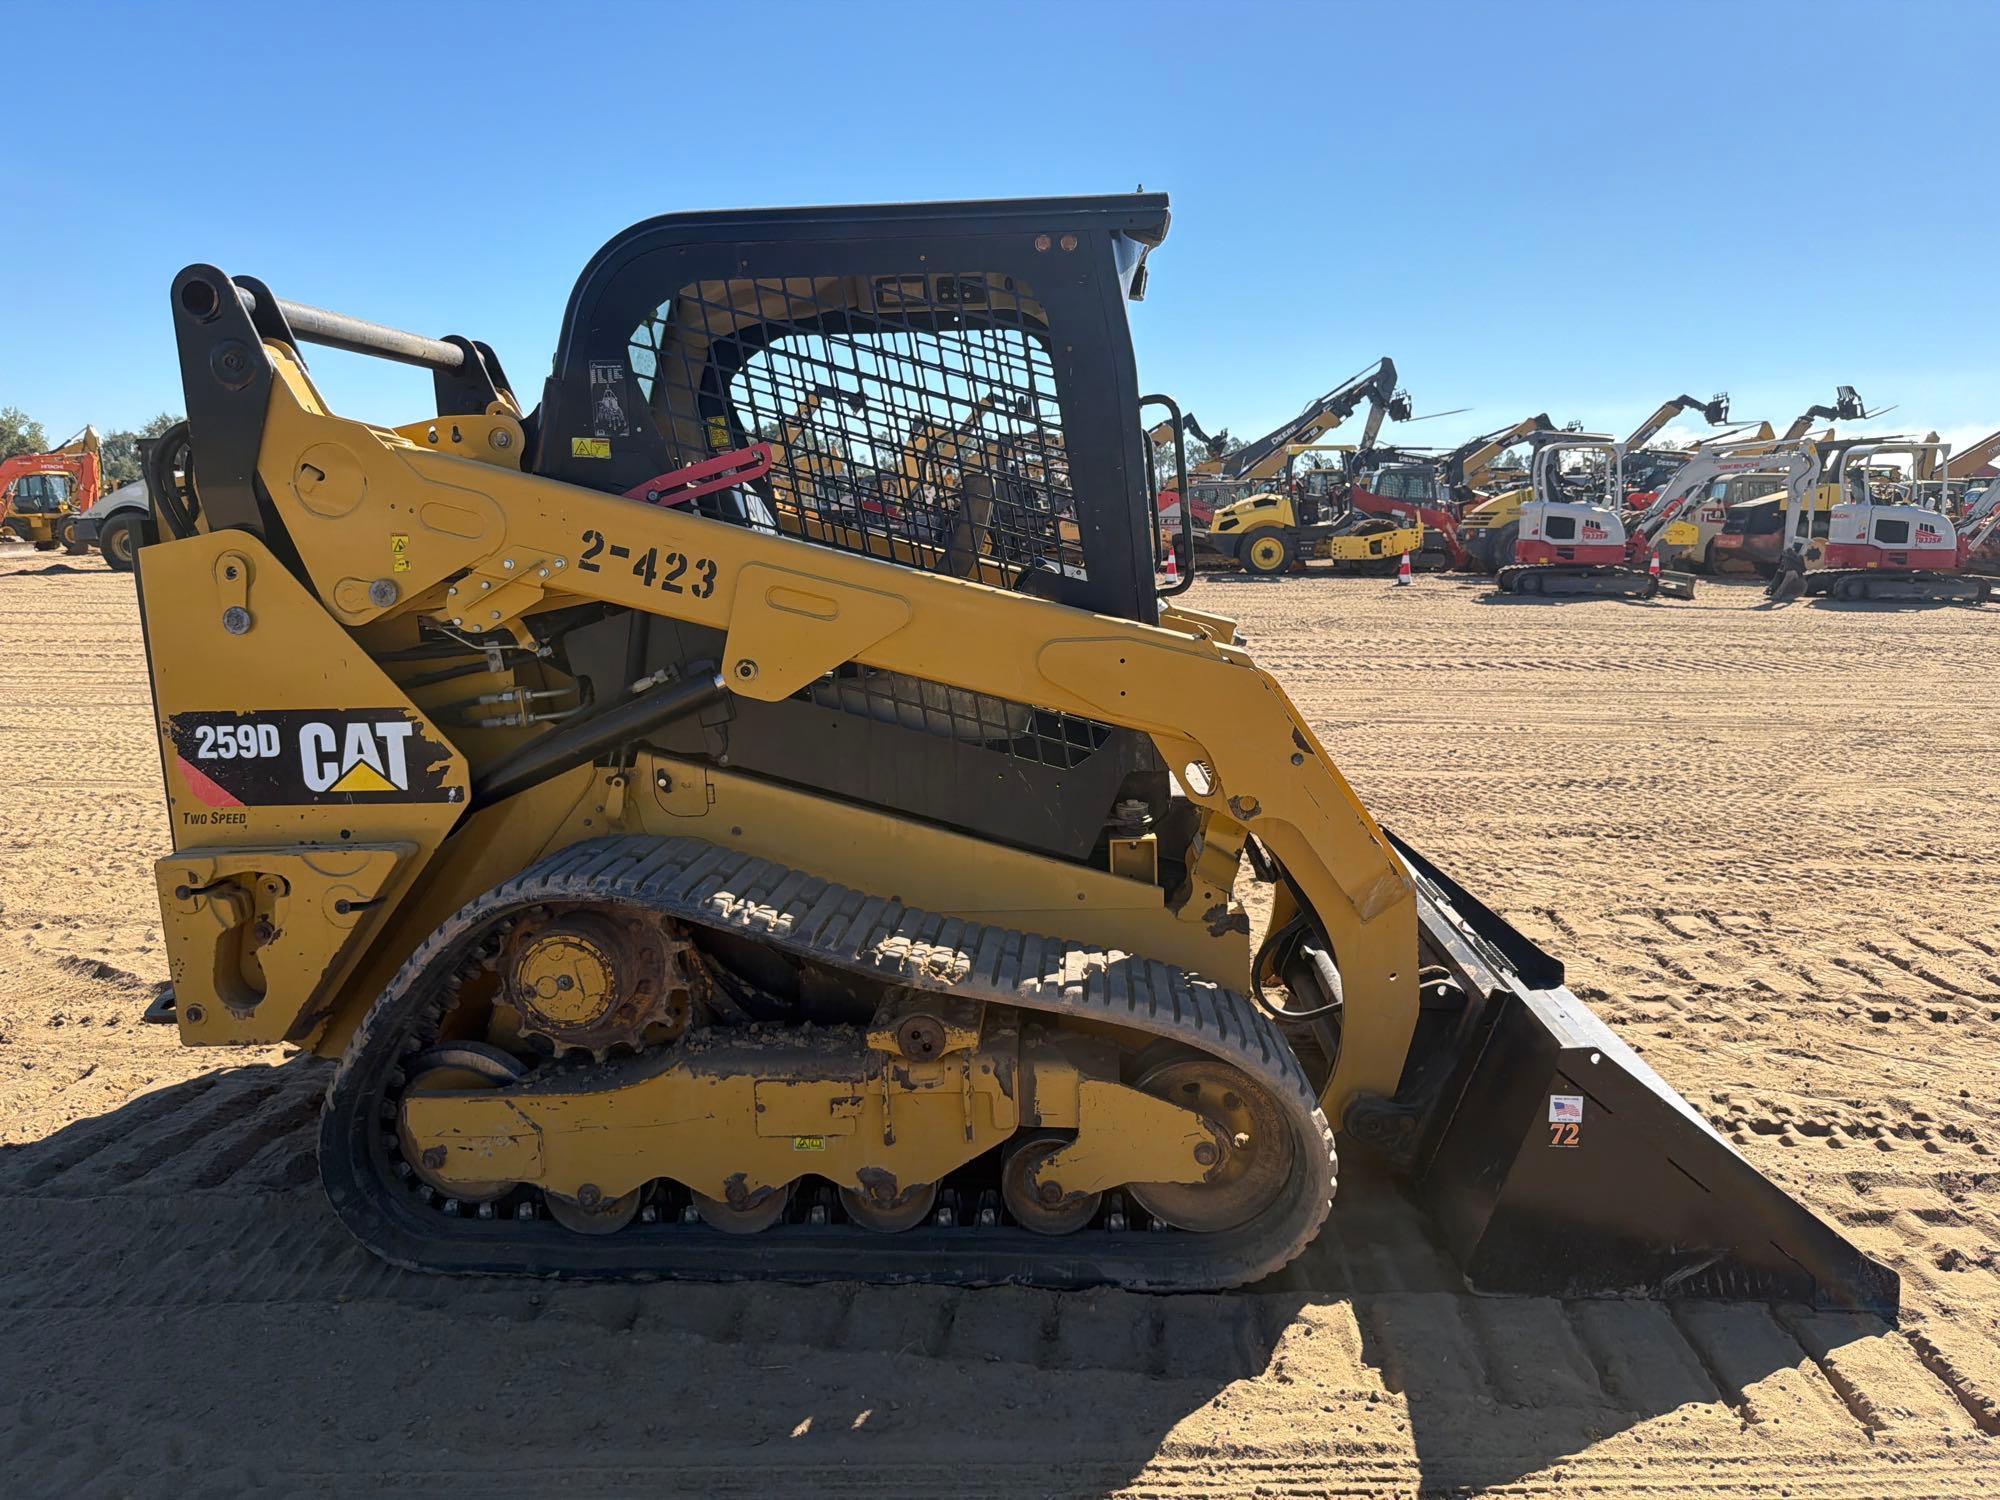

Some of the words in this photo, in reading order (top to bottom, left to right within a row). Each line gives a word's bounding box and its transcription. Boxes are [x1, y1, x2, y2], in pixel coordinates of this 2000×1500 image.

[1271, 424, 1298, 446] DEERE
[1718, 461, 1760, 471] TAKEUCHI
[577, 529, 718, 599] 2-423
[195, 724, 281, 760] 259D
[298, 721, 414, 792] CAT
[1550, 1123, 1580, 1145] 72
